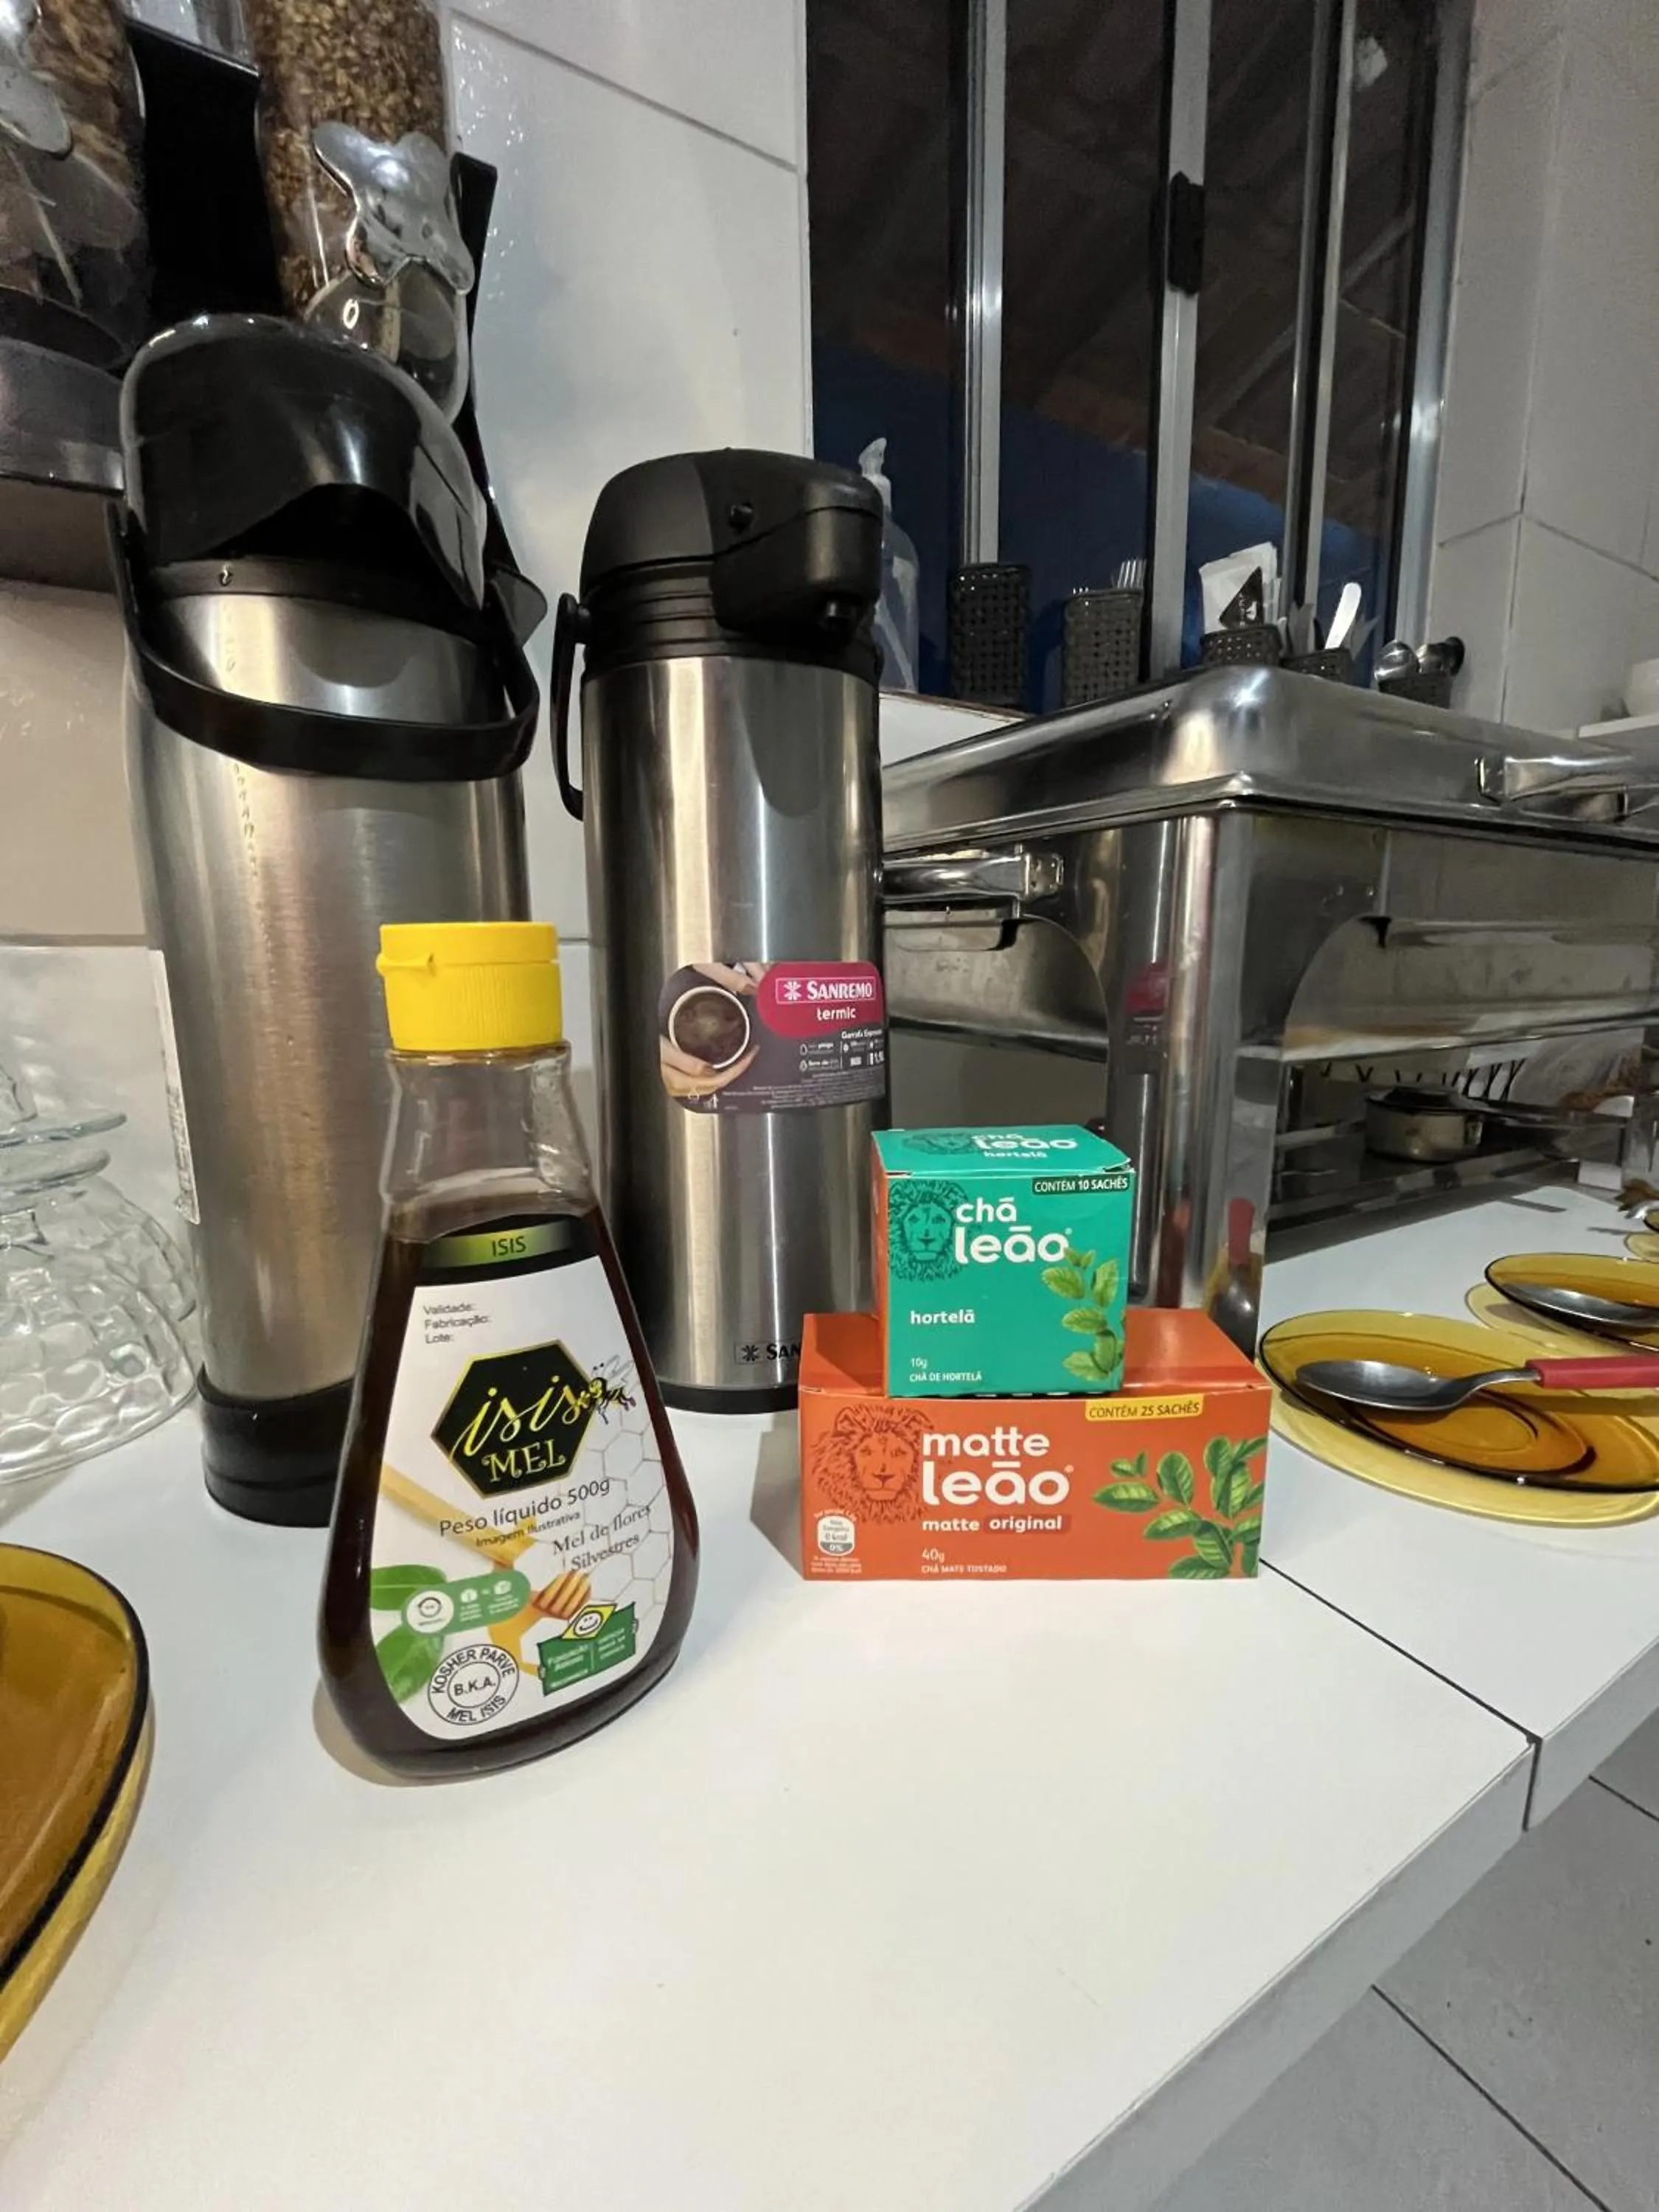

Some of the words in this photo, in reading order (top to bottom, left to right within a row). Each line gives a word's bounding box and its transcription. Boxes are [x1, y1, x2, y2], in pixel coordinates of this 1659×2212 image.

[807, 981, 872, 1001] SANREMO
[816, 1006, 857, 1021] termic
[1078, 1179, 1089, 1191] 10
[492, 1235, 526, 1257] ISIS
[954, 1225, 1069, 1265] leão
[910, 1309, 975, 1325] hortelã
[1088, 1405, 1138, 1419] CONTÉM
[1141, 1405, 1155, 1416] 25
[1157, 1399, 1200, 1416] SACHÊS
[922, 1426, 1051, 1457] matte
[481, 1439, 566, 1482] MEL
[922, 1461, 1071, 1506] leão
[439, 1517, 487, 1537] Peso
[493, 1495, 562, 1526] líquido
[567, 1478, 611, 1506] 500g
[922, 1517, 981, 1532] matte
[989, 1514, 1062, 1534] original
[552, 1531, 585, 1555] Mel
[571, 1534, 640, 1571] Silvestres
[921, 1547, 945, 1562] 40g
[431, 1649, 476, 1694] KOSHER
[480, 1646, 516, 1678] PARVE
[445, 1707, 477, 1722] MEL
[480, 1695, 507, 1718] ISIS
